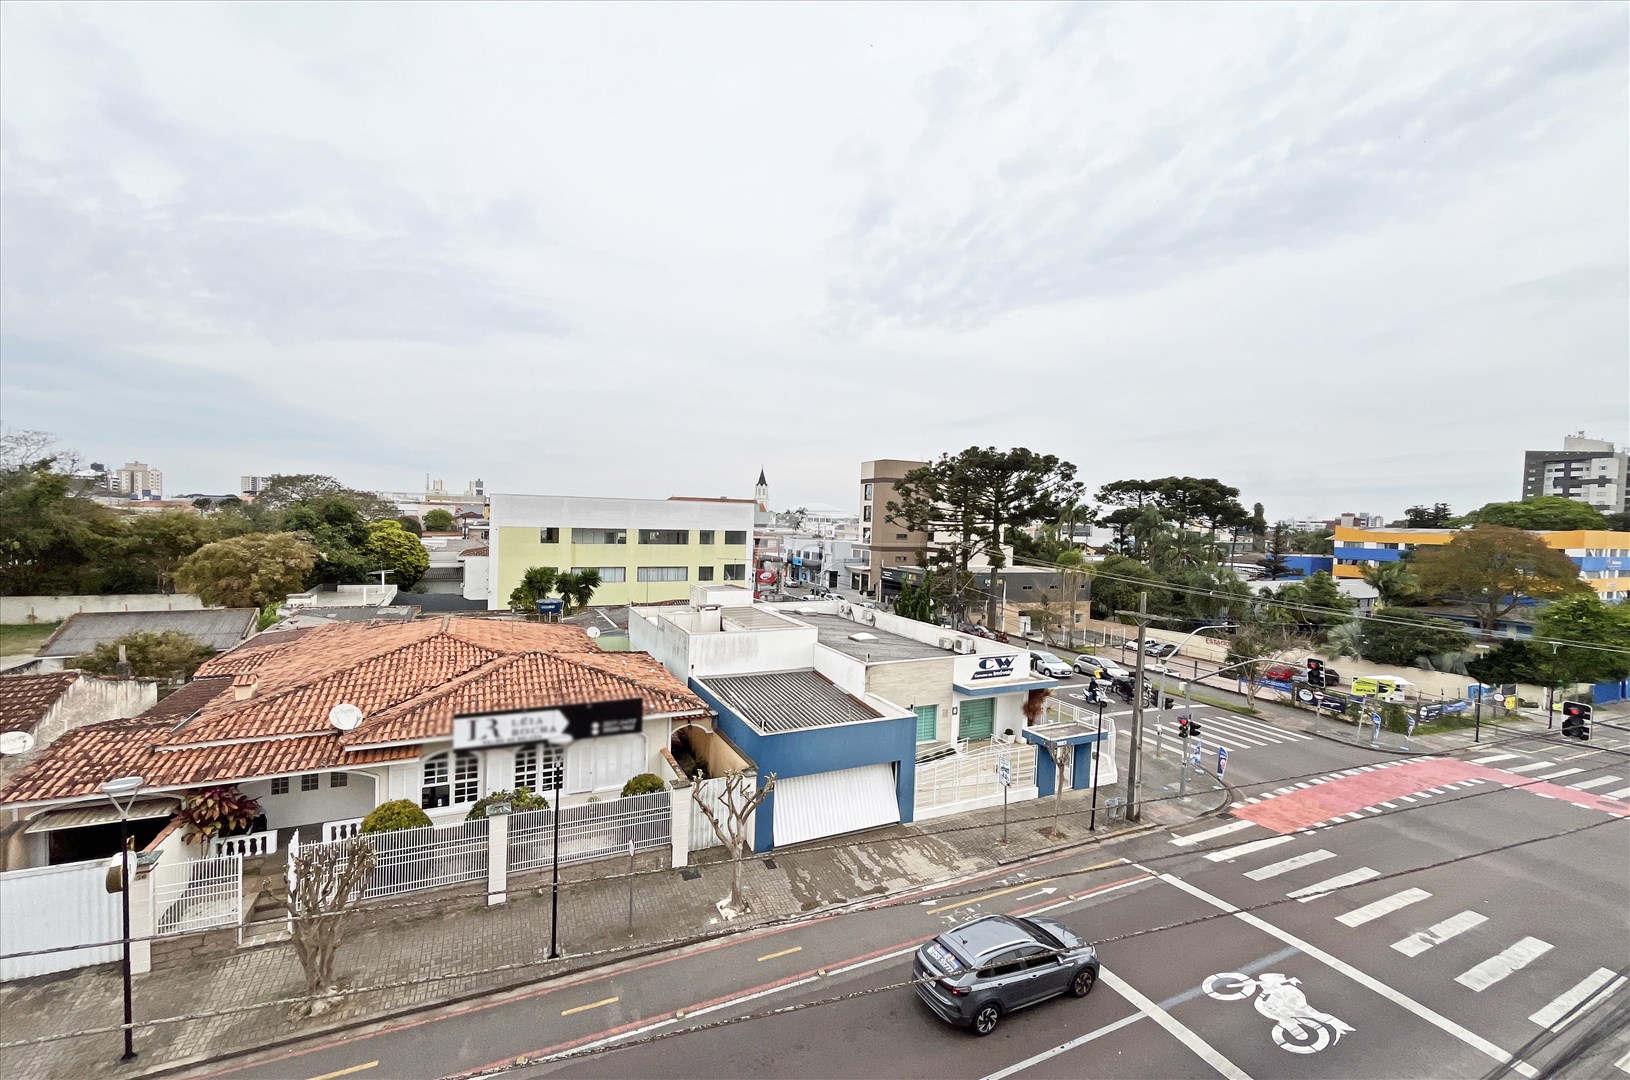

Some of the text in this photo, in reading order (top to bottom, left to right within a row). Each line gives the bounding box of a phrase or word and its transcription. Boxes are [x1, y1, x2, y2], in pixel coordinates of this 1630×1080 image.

[1205, 637, 1232, 647] ESTACIO
[979, 657, 1015, 669] CW
[511, 717, 544, 727] LÉIA
[511, 726, 557, 737] ROCHA
